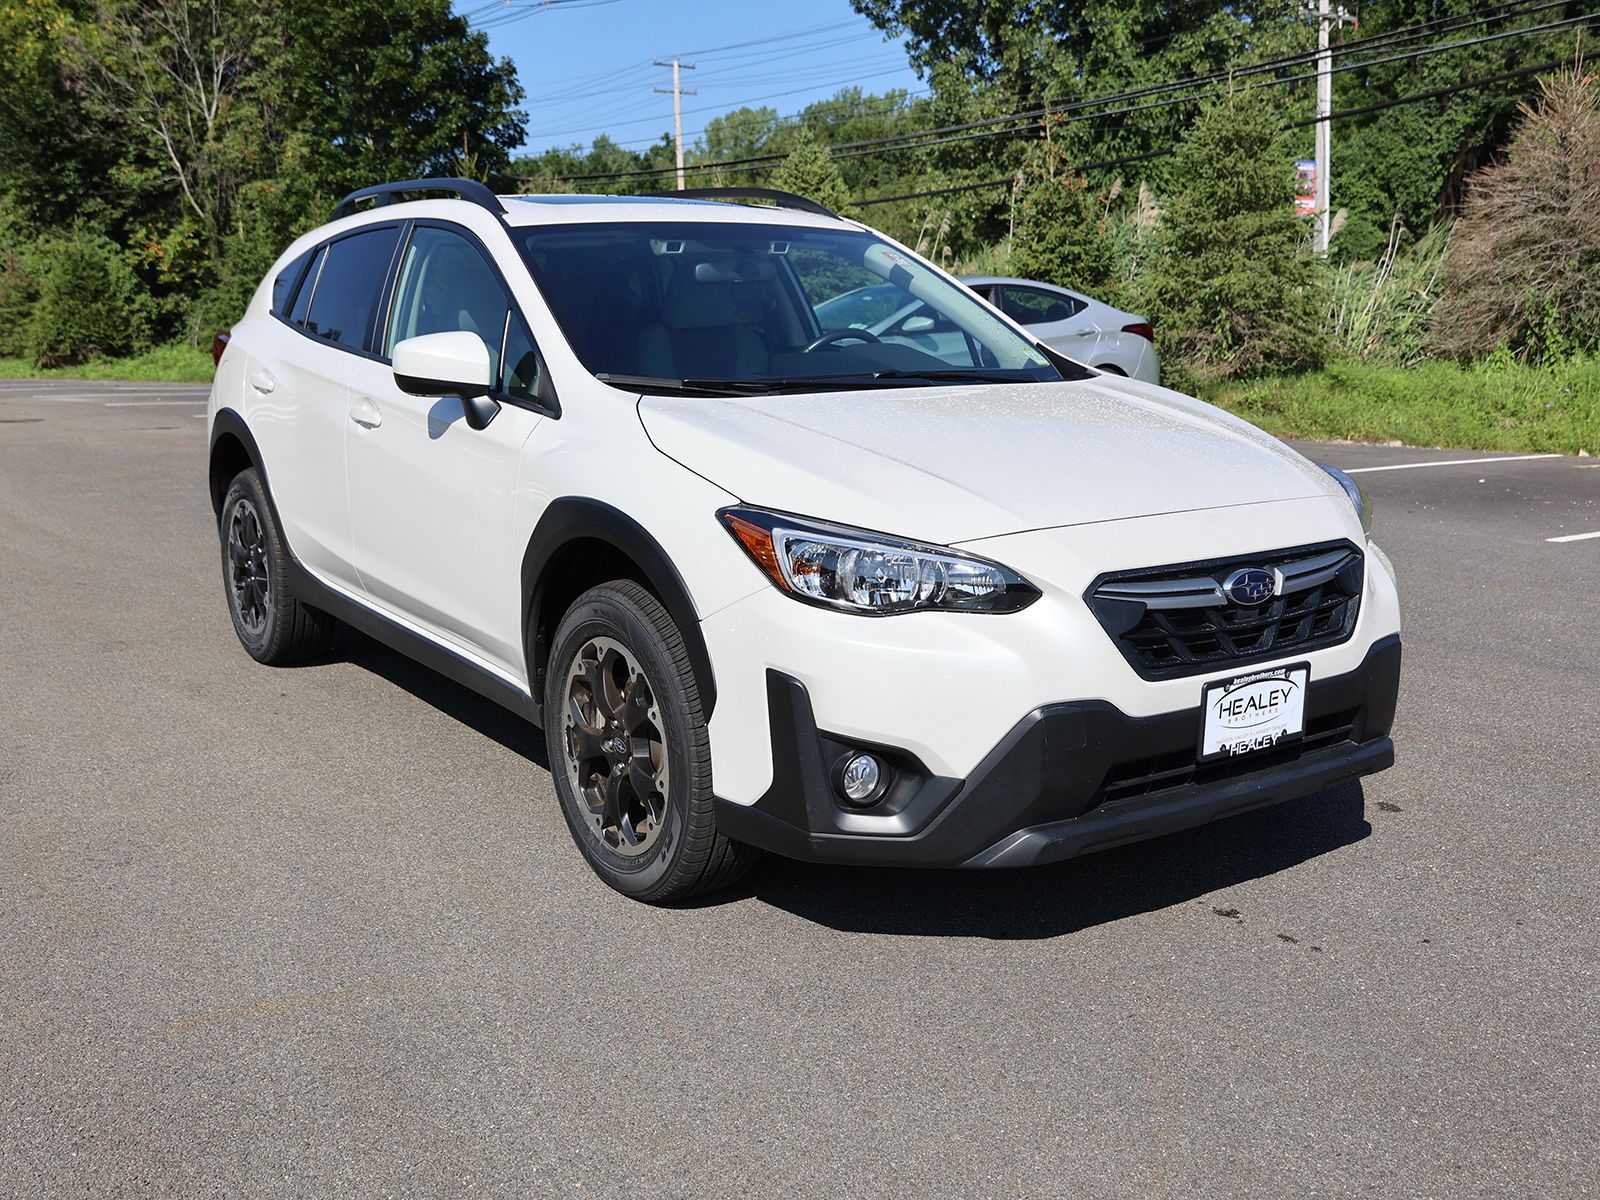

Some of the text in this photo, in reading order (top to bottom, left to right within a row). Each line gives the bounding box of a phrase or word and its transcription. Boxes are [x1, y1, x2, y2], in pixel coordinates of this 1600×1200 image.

[1219, 686, 1293, 719] HEALEY
[1228, 708, 1279, 724] BROTHERS
[1230, 734, 1279, 757] HEALEY
